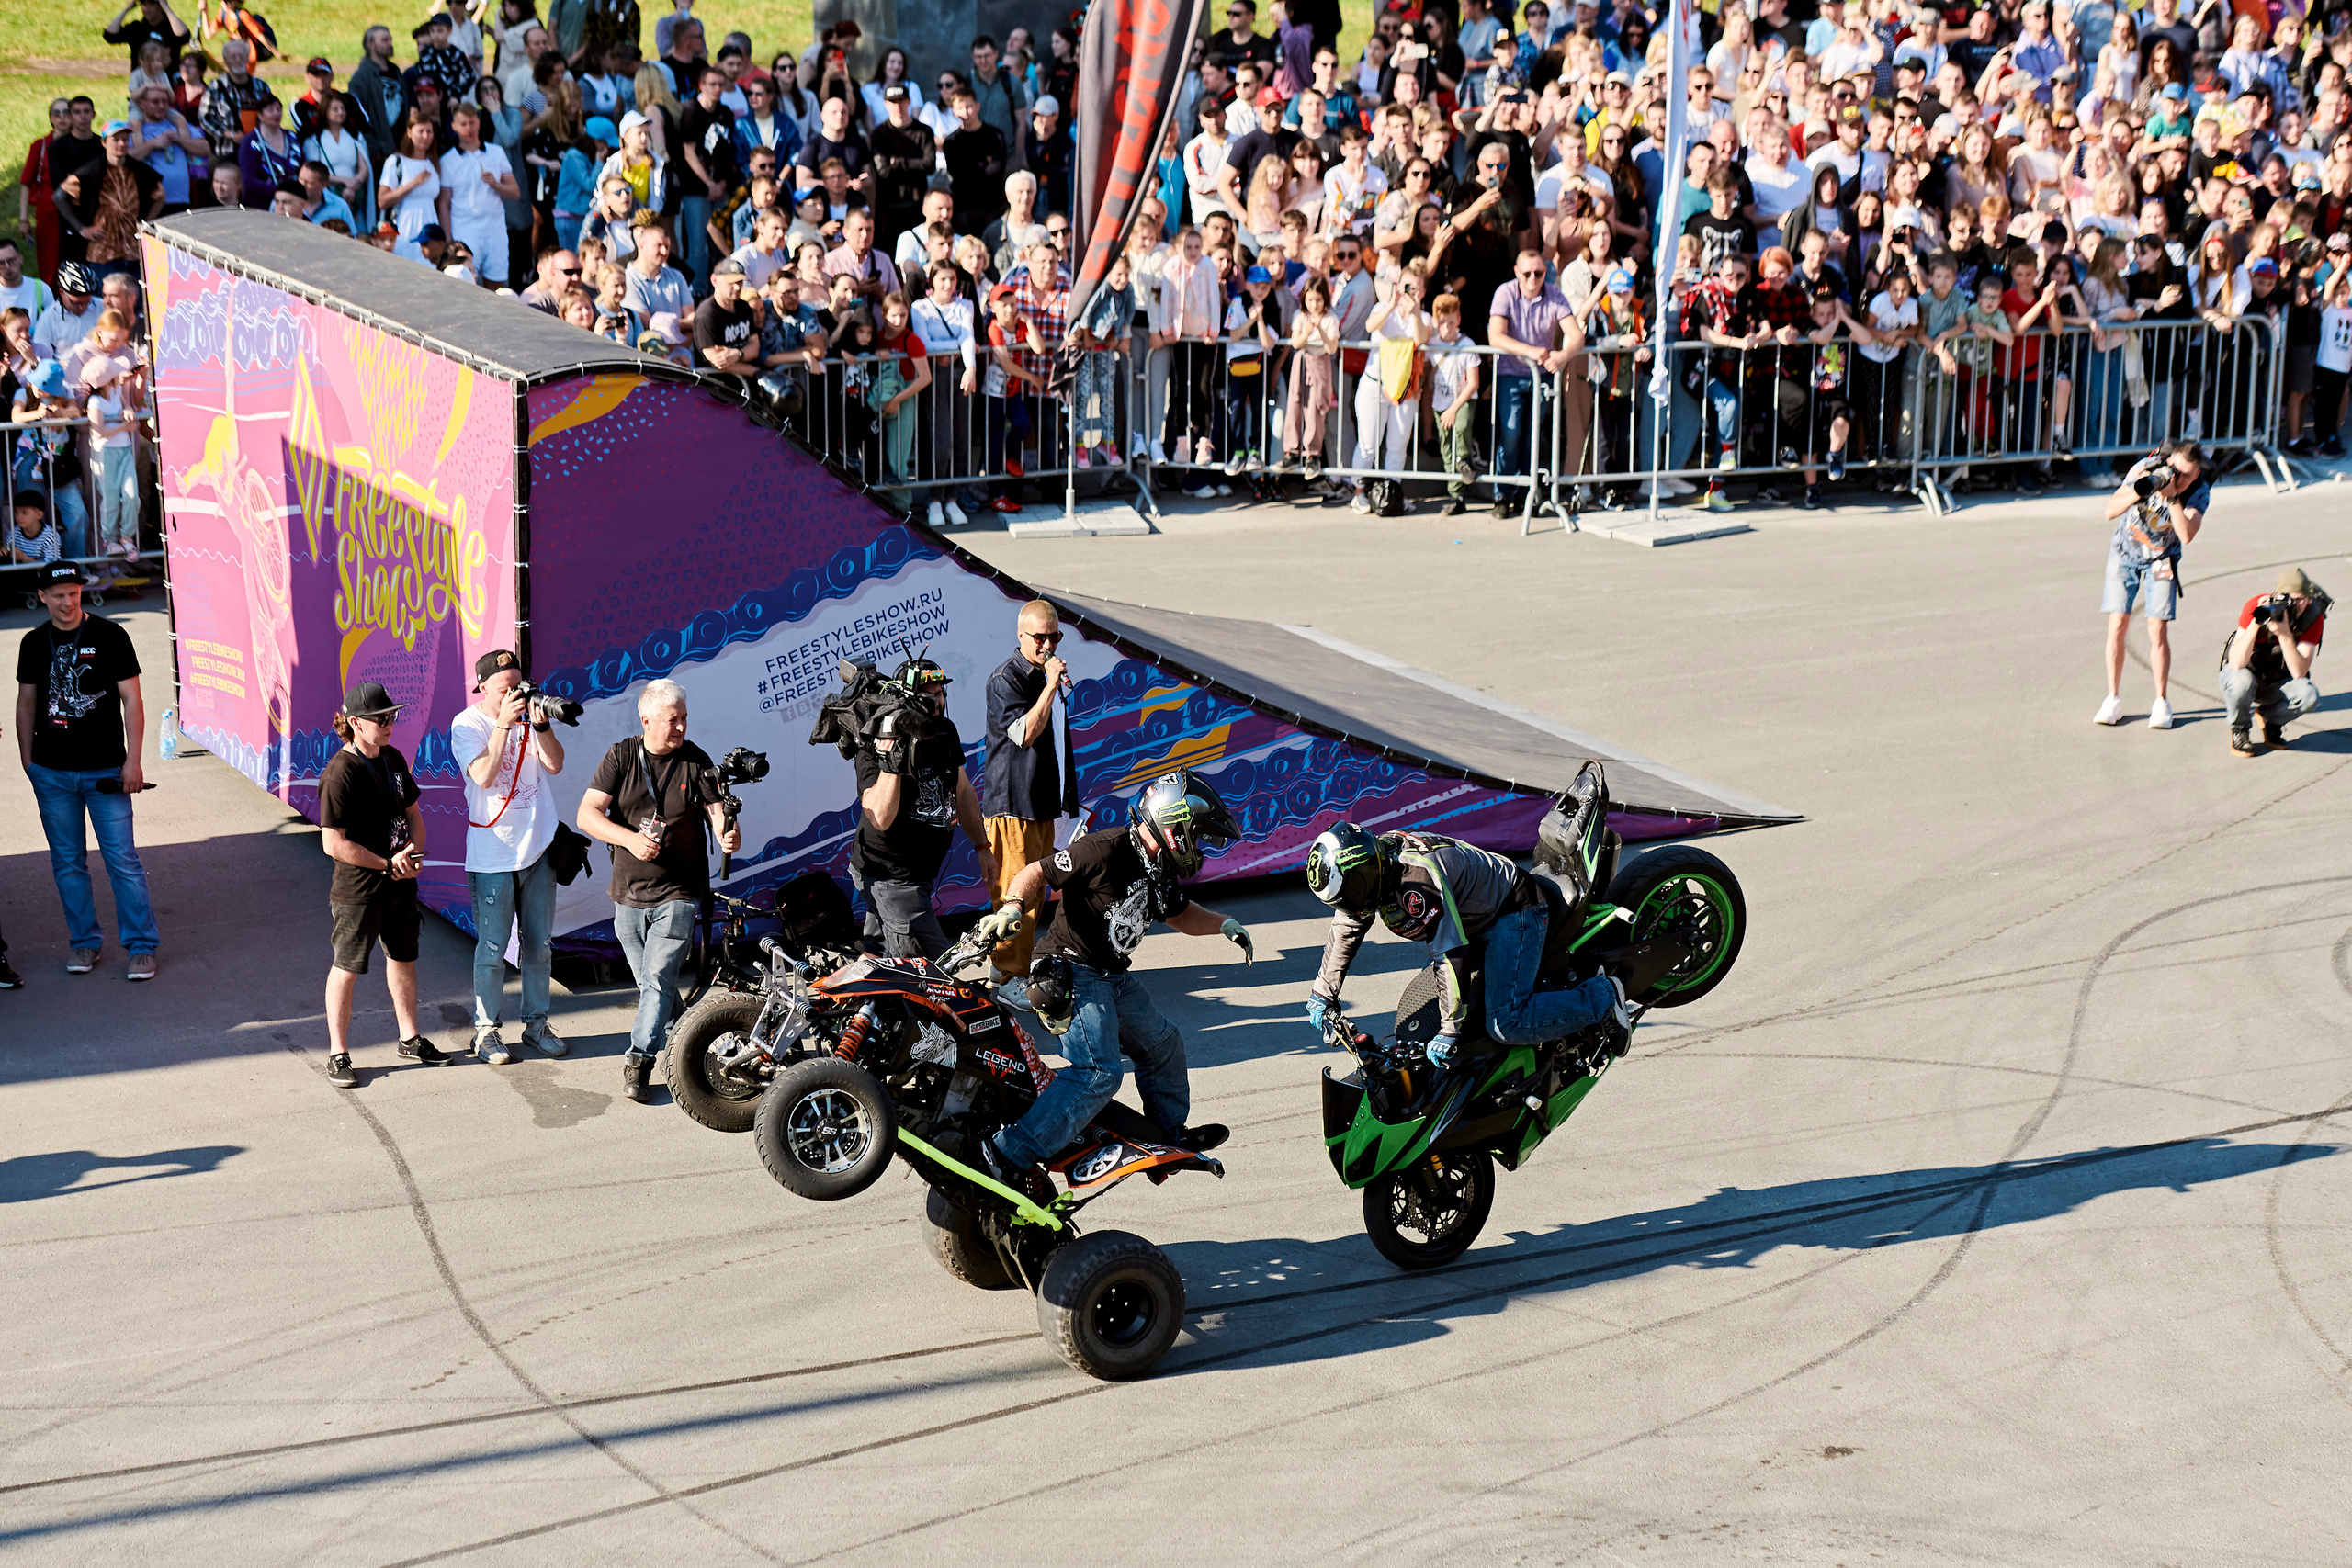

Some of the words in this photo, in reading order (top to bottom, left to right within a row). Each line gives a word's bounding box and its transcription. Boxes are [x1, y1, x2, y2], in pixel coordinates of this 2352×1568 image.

[765, 588, 943, 673] FREESTYLESHOW.RU
[185, 638, 243, 663] #FREESTYLEBIKESHOW
[191, 656, 245, 682] FREESTYLESHOW.RU
[190, 671, 245, 699] @FREESTYLEBIKESHOW
[1164, 829, 1177, 850] MOTUL
[975, 1047, 1026, 1073] LEGEND
[983, 1060, 1001, 1070] STUNT
[1001, 1067, 1017, 1076] TEAM
